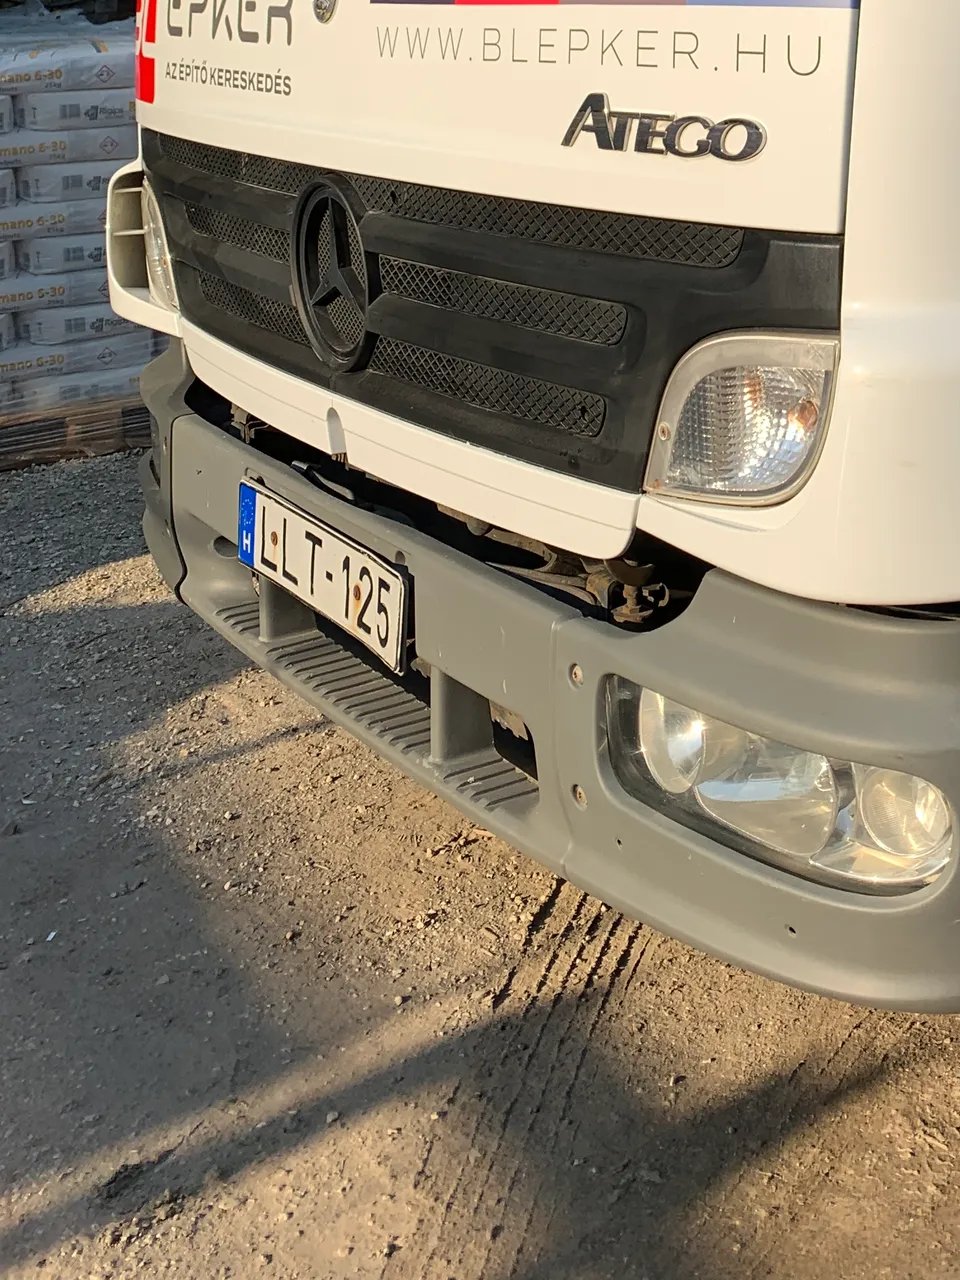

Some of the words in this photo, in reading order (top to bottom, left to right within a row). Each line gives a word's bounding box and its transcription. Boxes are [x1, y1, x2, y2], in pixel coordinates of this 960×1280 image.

[165, 61, 177, 81] AZ
[179, 57, 207, 85] ÉPÍTŐ
[209, 68, 292, 97] KERESKEDÉS
[376, 26, 825, 77] WWW.BLEPKER.HU
[243, 530, 251, 554] H
[261, 505, 390, 649] LLT-125
